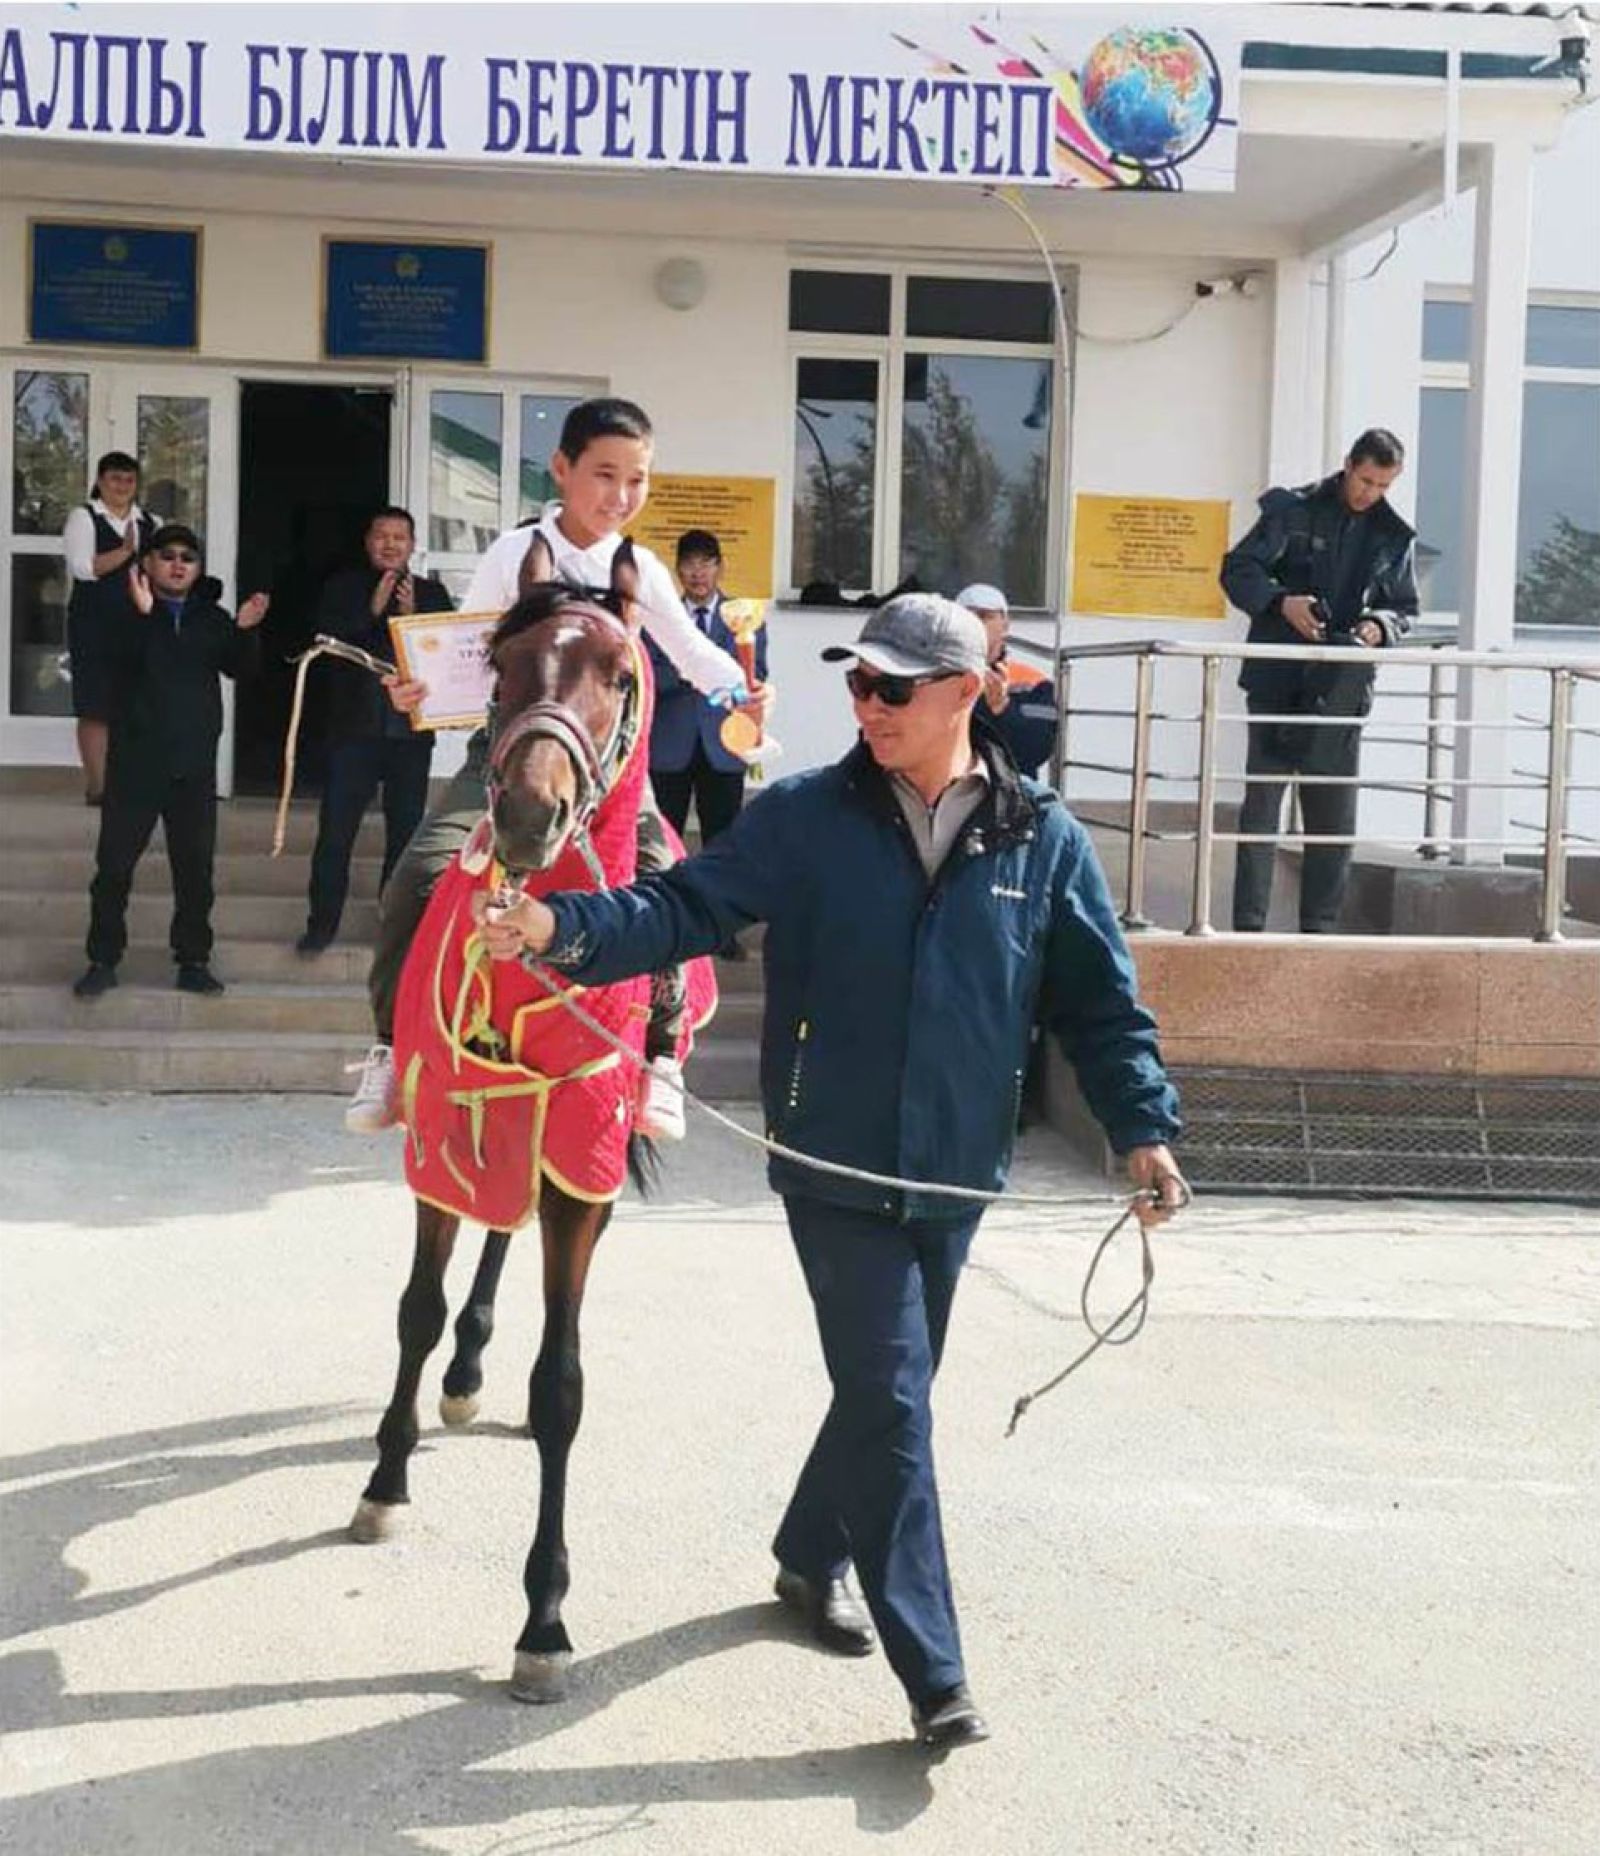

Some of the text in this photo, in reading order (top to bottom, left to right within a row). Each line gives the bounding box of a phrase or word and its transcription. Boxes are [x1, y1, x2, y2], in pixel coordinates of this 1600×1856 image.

[244, 43, 446, 150] БІЛІМ
[483, 57, 750, 165] БЕРЕТІН
[786, 72, 1055, 178] МЕКТЕП
